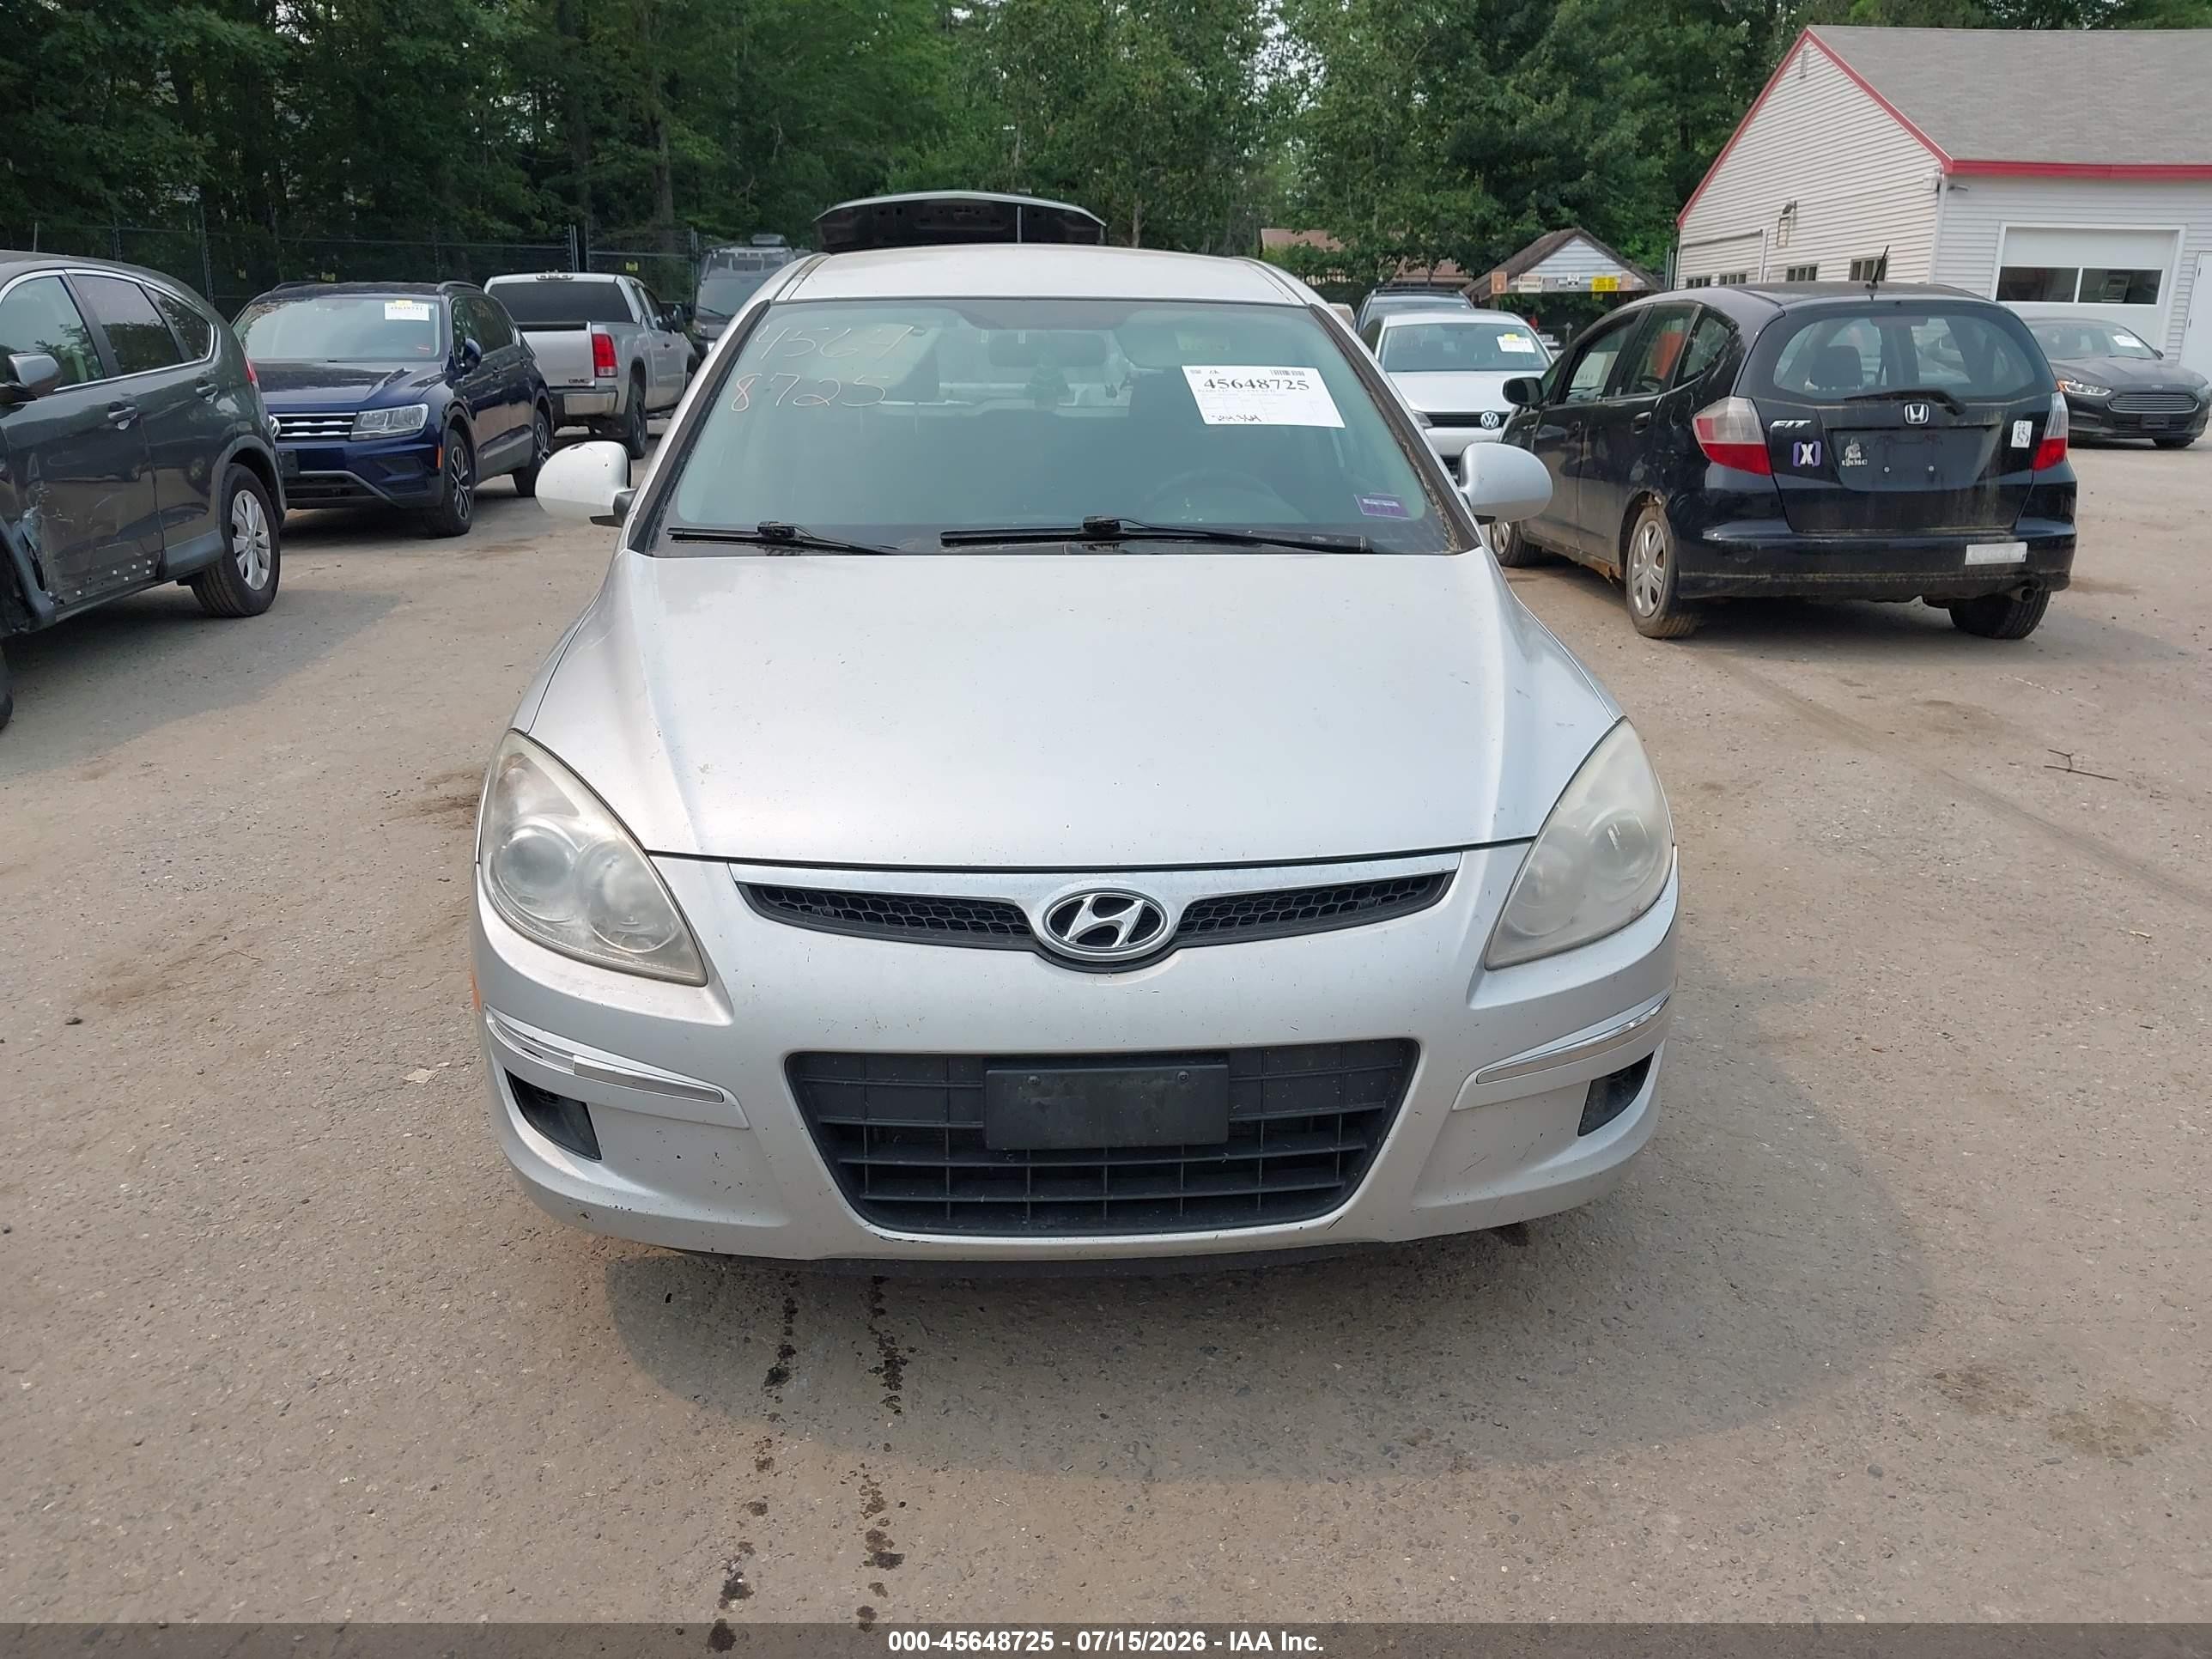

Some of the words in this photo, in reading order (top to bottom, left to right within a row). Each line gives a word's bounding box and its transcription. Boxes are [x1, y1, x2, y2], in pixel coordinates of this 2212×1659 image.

[1203, 378, 1310, 391] 45648725
[731, 372, 890, 412] 8725
[1770, 420, 1811, 428] FIT
